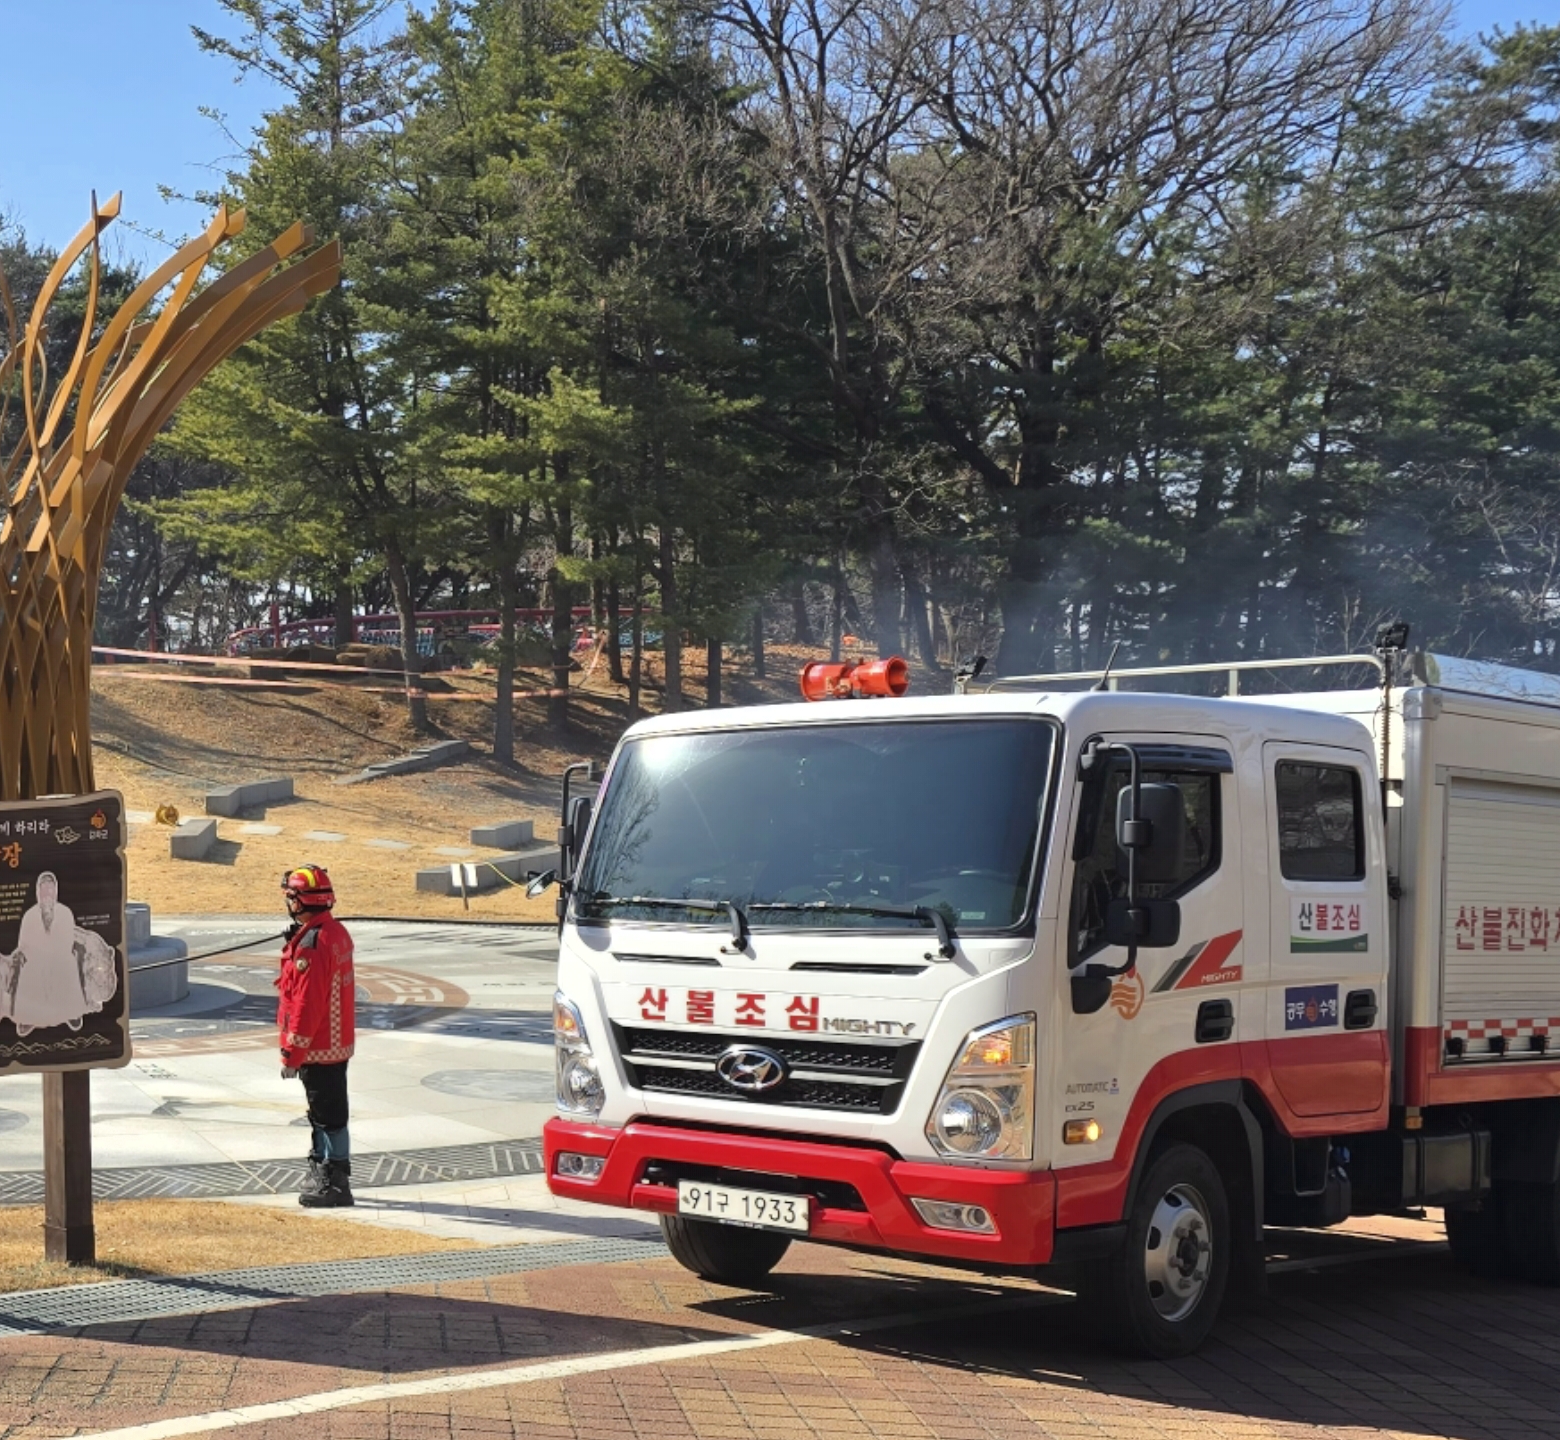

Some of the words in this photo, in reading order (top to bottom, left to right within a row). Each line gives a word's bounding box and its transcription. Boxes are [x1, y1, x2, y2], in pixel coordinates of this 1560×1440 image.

[1297, 902, 1361, 932] 산불조심
[1200, 970, 1238, 983] MIGHTY
[637, 986, 821, 1032] 산불조심
[1287, 1000, 1305, 1021] 공무
[1319, 998, 1337, 1020] 수행
[823, 1016, 917, 1037] MIGHTY
[1065, 1081, 1109, 1095] AUTOMATIC
[689, 1188, 729, 1213] 91구
[742, 1195, 796, 1224] 1933
